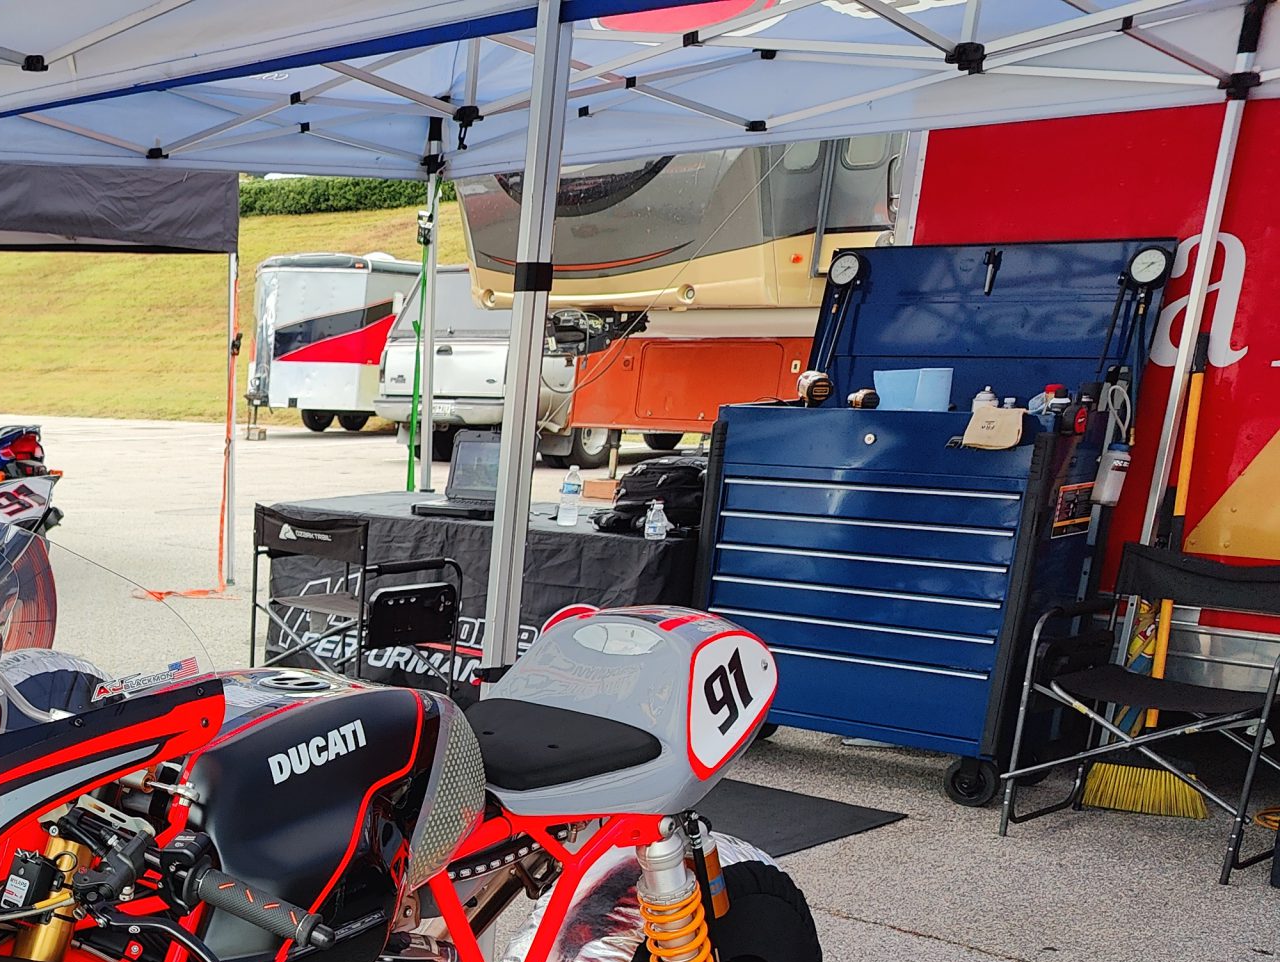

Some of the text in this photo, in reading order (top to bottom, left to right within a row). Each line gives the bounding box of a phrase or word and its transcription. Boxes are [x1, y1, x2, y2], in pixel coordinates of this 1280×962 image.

[123, 671, 174, 690] BLACKMON
[703, 647, 754, 736] 91
[268, 719, 367, 785] DUCATI
